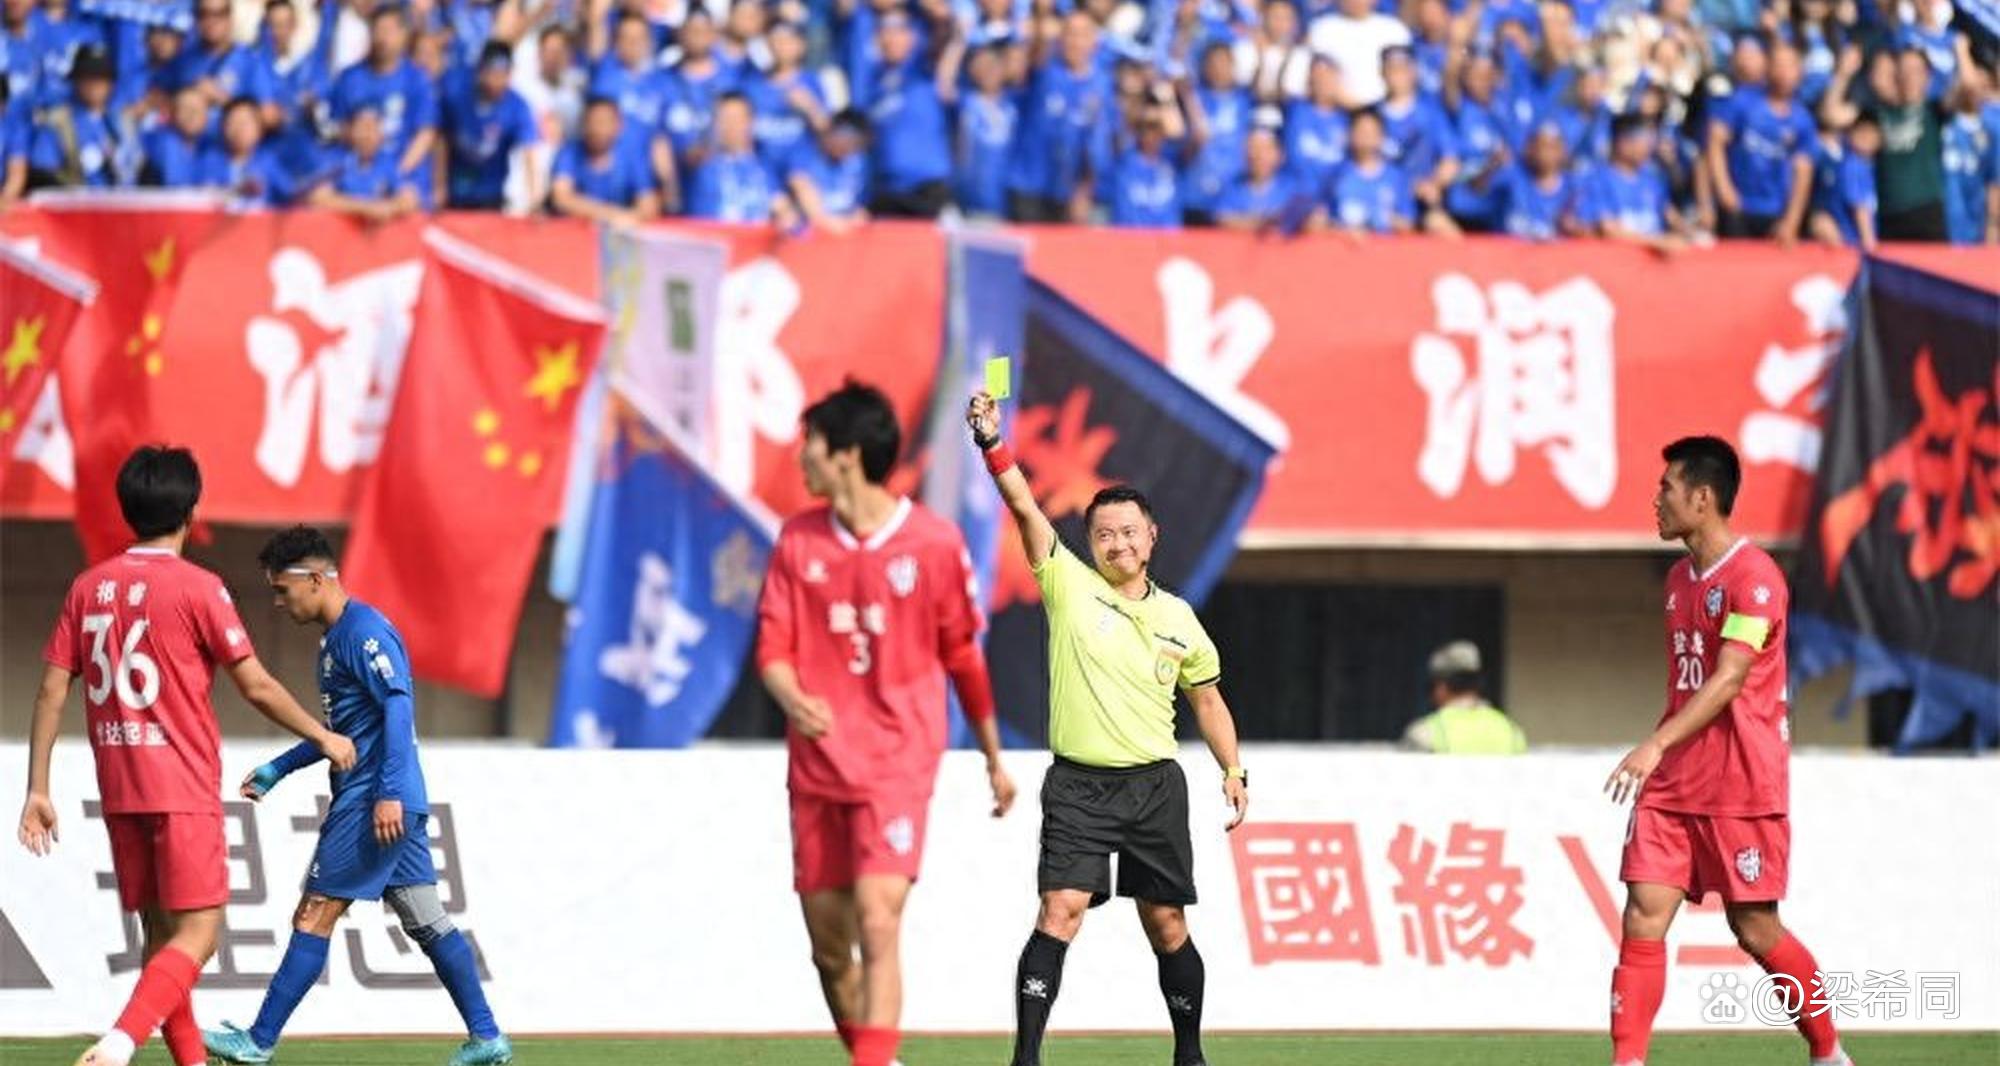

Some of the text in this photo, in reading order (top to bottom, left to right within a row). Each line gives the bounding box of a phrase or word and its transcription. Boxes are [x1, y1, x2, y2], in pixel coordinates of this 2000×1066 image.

[82, 614, 160, 710] 36
[848, 632, 872, 676] 3
[1676, 656, 1704, 691] 20
